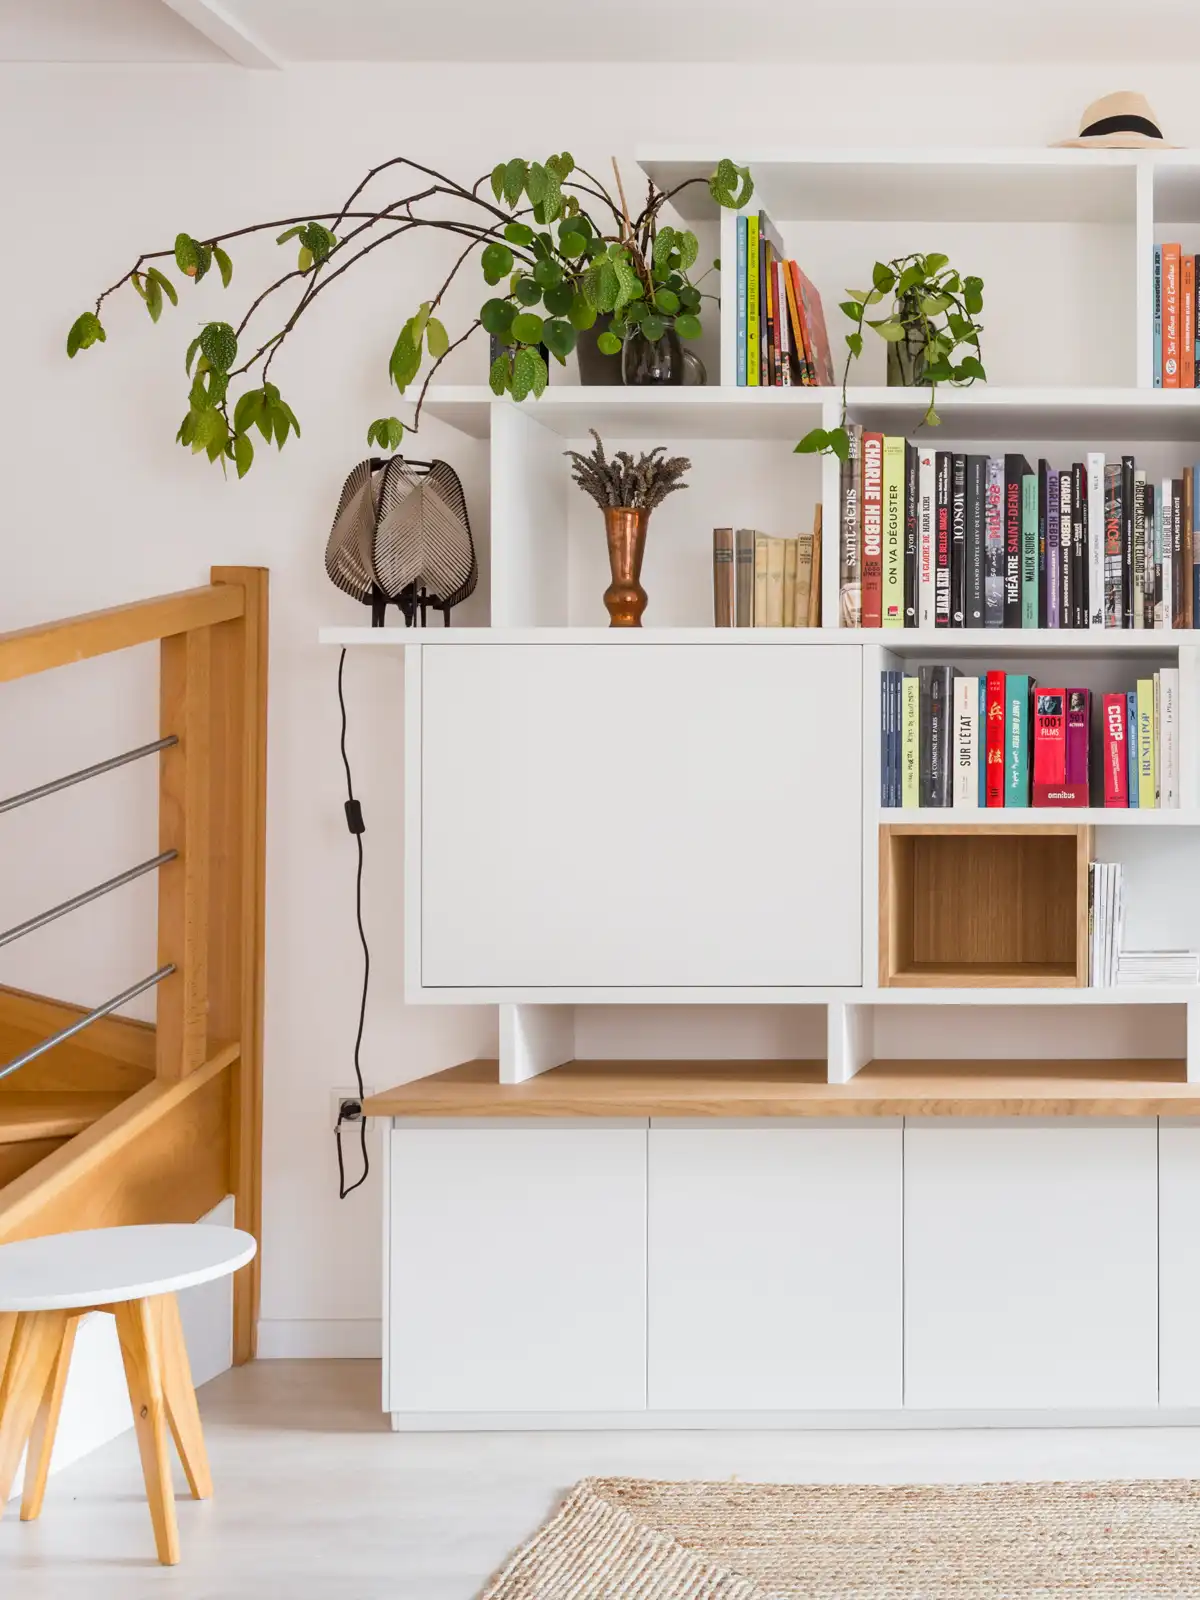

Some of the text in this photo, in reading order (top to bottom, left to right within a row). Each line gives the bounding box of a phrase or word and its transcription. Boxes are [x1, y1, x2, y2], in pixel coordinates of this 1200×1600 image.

[1167, 295, 1176, 303] la
[1167, 305, 1176, 314] de
[1167, 315, 1176, 339] l'album
[1167, 341, 1176, 355] Sur
[864, 439, 881, 556] CHARLIE HEBDO
[1060, 475, 1071, 513] CHARLIE
[1134, 480, 1145, 501] PABLO
[907, 517, 916, 528] 25
[939, 508, 947, 530] IMAGES
[953, 491, 964, 544] MOSCOU
[974, 519, 980, 528] DE
[989, 485, 1001, 539] MAI 68
[1048, 476, 1059, 548] CHARLIE HEBDO
[1134, 501, 1145, 530] PICASSO
[1162, 505, 1171, 526] GHETTO
[845, 488, 857, 567] saint-denis
[887, 484, 898, 585] ON VA DÉGUSTER
[922, 496, 930, 582] LA GLOIRE DE HARA KIRI
[1060, 515, 1071, 547] HEBDO
[1107, 518, 1120, 555] LYON
[906, 533, 915, 555] Lyon
[939, 531, 947, 553] BELLES
[1004, 483, 1019, 604] THÉÂTRE SAINT-DENIS
[1134, 531, 1145, 548] PAUL
[1162, 527, 1171, 554] BEAUTIFUL
[939, 556, 947, 565] LES
[1024, 532, 1035, 582] MALICK SIDIBÉ
[936, 568, 950, 588] KIRI
[936, 589, 950, 614] HARA
[974, 591, 980, 599] LE
[1039, 717, 1062, 727] 1001
[1041, 728, 1059, 736] FILMS
[1107, 705, 1123, 741] CCCP
[931, 733, 938, 742] DE
[959, 715, 971, 767] SUR L'ÉTAT
[1142, 712, 1151, 777] FRENCH POP
[931, 771, 938, 779] LA
[1047, 791, 1075, 800] omnibus
